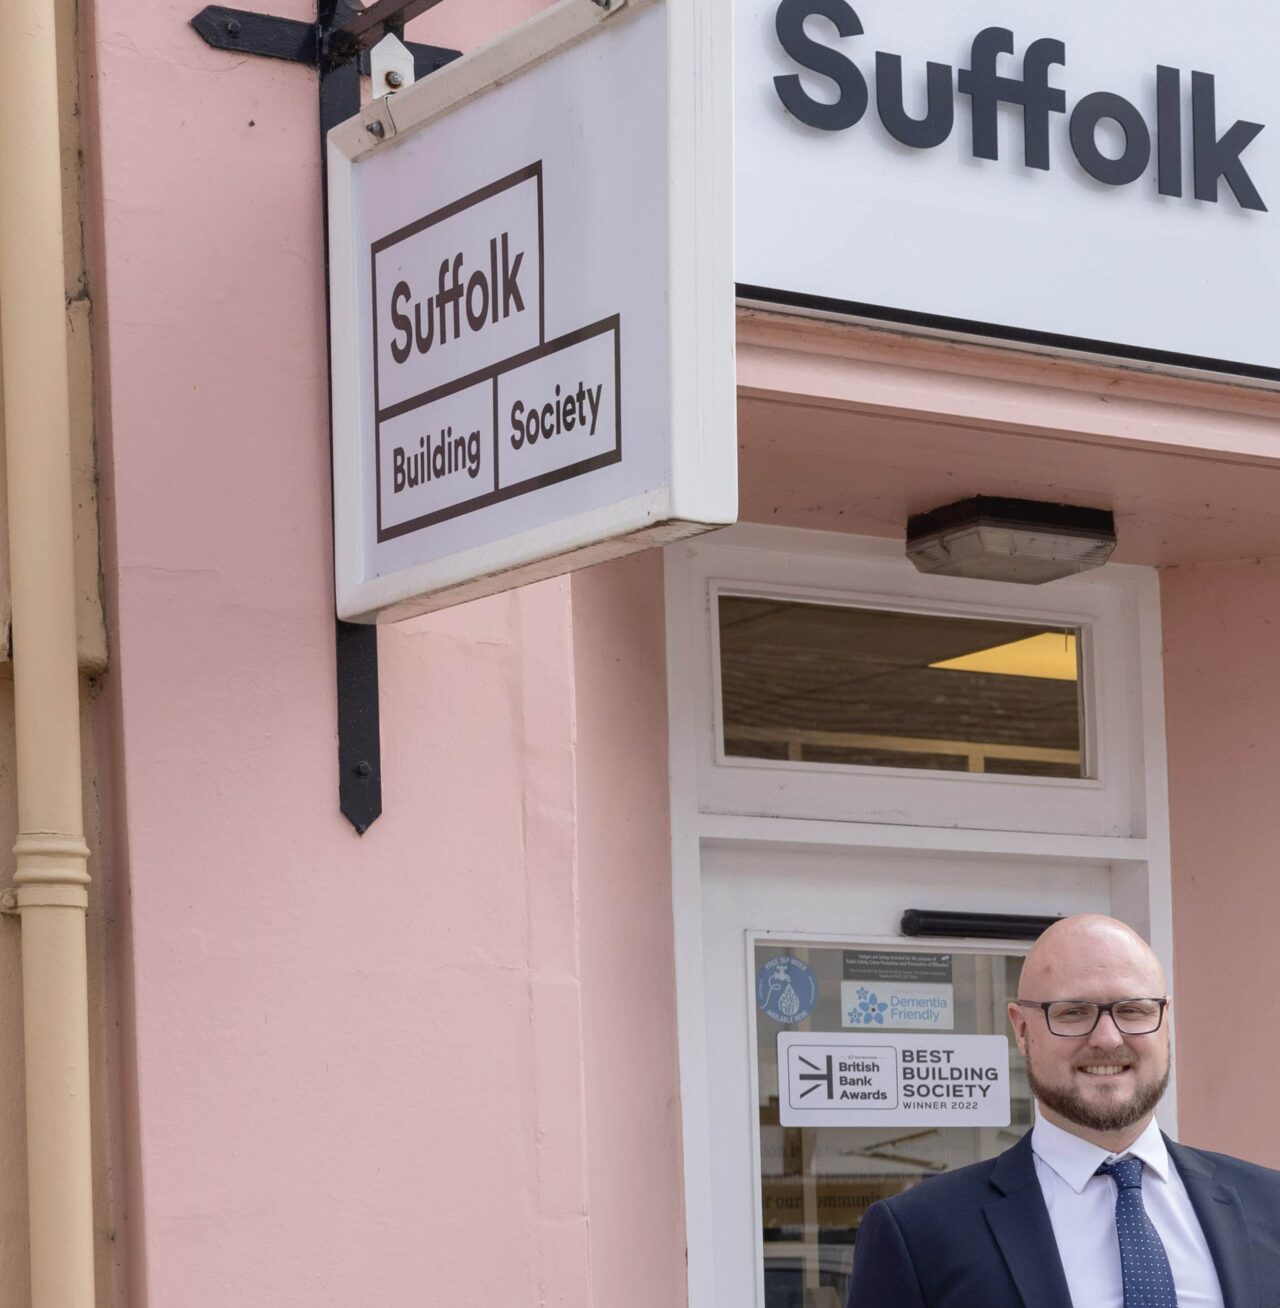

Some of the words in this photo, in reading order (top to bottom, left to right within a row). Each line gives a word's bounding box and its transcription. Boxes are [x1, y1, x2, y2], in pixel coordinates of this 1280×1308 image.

[773, 0, 1269, 213] Suffolk
[390, 231, 525, 364] Suffolk
[510, 381, 602, 451] Society
[393, 425, 481, 494] Building
[890, 995, 947, 1009] Dementia
[890, 1008, 940, 1023] Friendly
[902, 1049, 955, 1063] BEST
[838, 1061, 880, 1072] British
[839, 1076, 872, 1086] Bank
[902, 1067, 998, 1081] BUILDING
[839, 1089, 888, 1100] Awards
[902, 1084, 992, 1098] SOCIETY
[902, 1101, 947, 1110] WINNER
[951, 1101, 979, 1110] 2022
